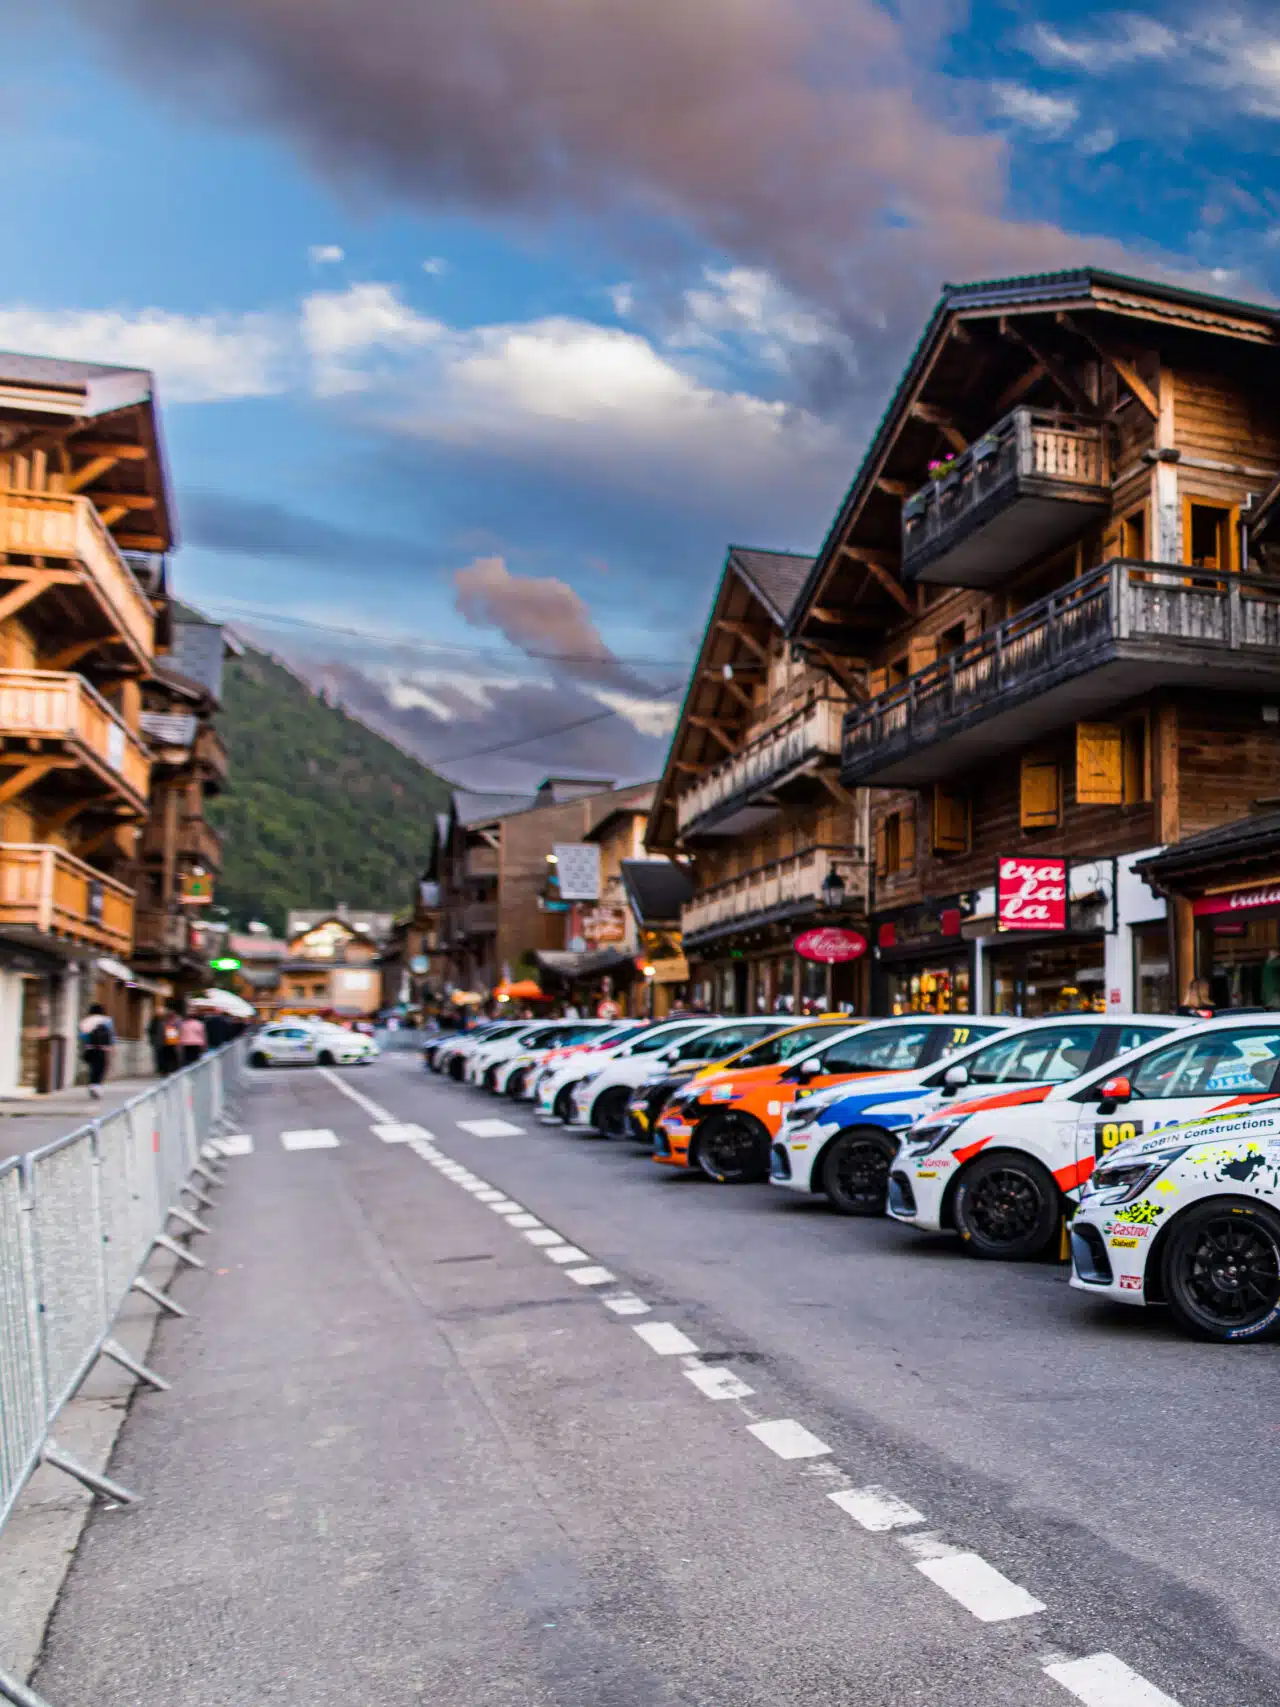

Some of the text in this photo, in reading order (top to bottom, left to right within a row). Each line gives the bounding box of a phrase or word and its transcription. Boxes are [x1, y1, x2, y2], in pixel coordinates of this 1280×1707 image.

[1000, 861, 1066, 881] tra
[1012, 880, 1066, 900] la
[1000, 899, 1051, 920] la
[1141, 1133, 1182, 1153] ROBIN
[1183, 1118, 1275, 1140] Constructions
[1112, 1222, 1150, 1238] Castrol
